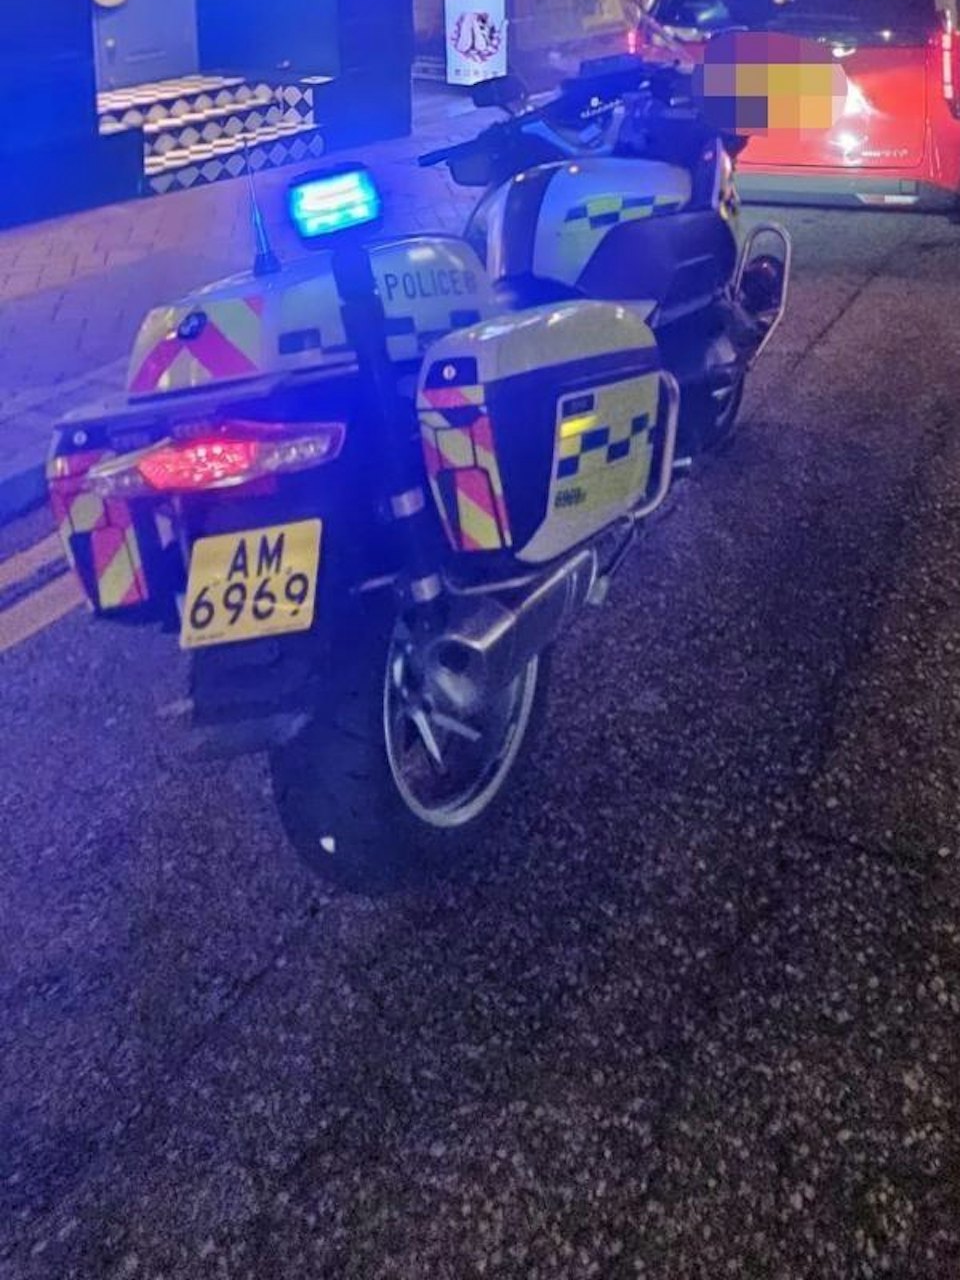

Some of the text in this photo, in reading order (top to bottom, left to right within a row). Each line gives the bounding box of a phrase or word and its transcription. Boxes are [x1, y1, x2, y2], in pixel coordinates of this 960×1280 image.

[384, 269, 463, 301] POLICE
[227, 532, 285, 581] AM
[190, 572, 309, 630] 6969
